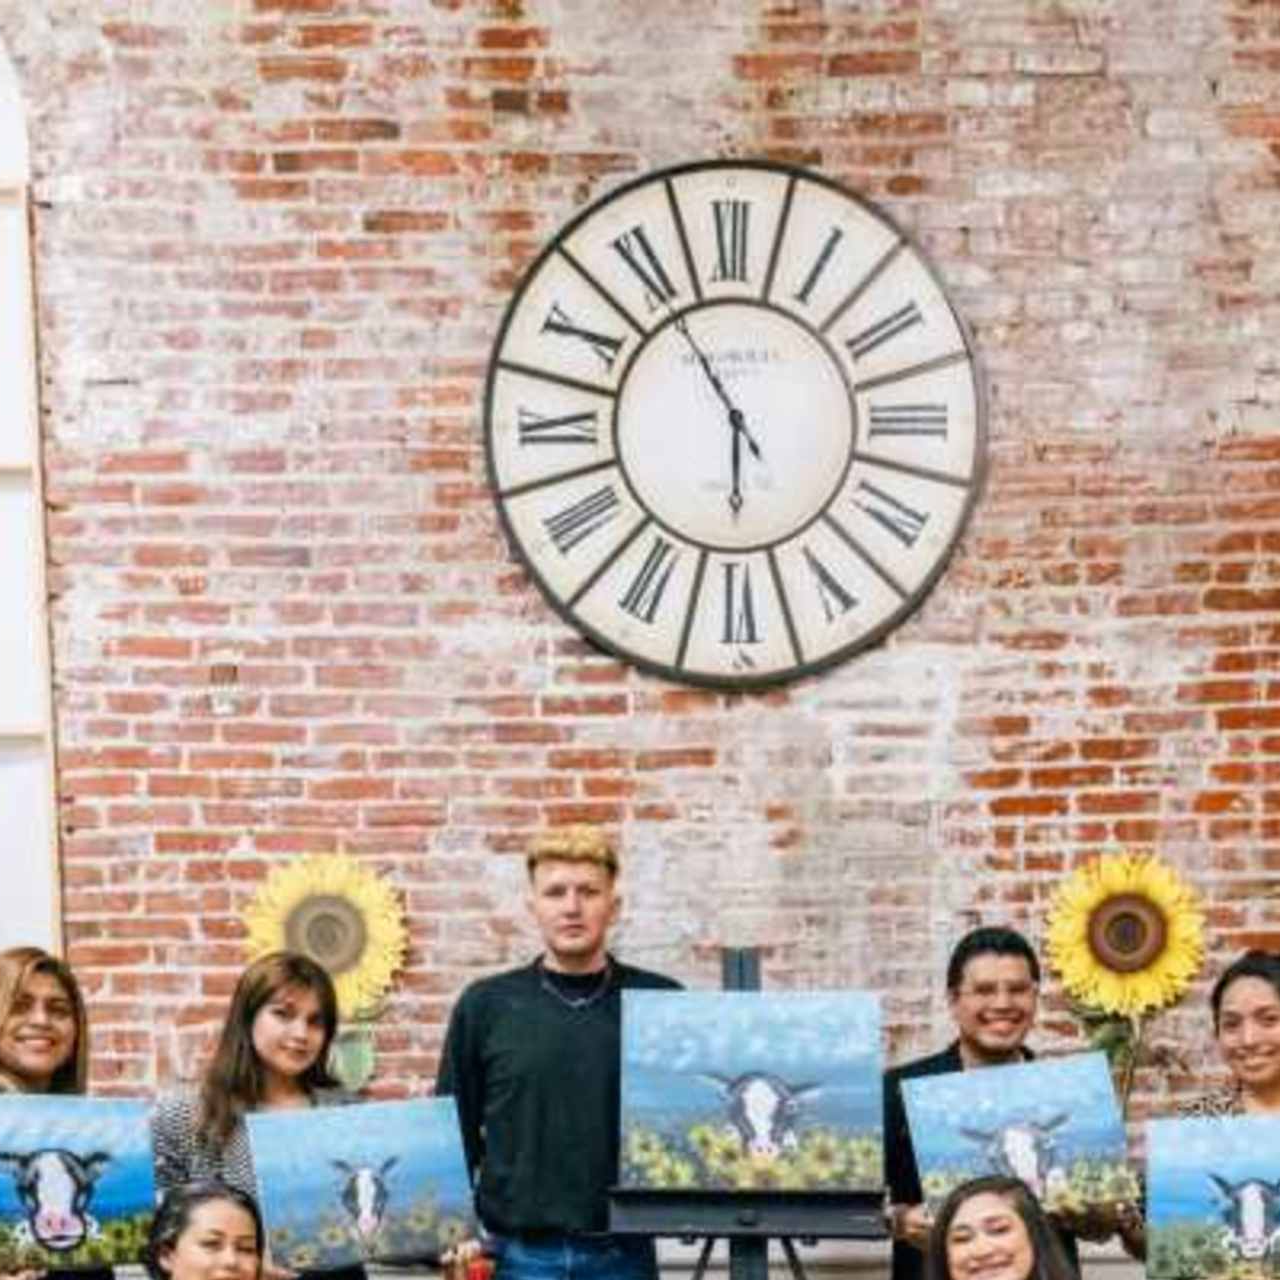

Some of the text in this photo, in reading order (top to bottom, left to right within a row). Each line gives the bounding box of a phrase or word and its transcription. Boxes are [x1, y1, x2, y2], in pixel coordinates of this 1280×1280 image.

[610, 224, 677, 313] XI
[710, 199, 752, 282] XII
[793, 226, 844, 304] I
[541, 302, 626, 373] X
[845, 301, 926, 360] II
[518, 406, 599, 444] IX
[869, 403, 949, 437] III
[543, 484, 622, 556] VIII
[850, 480, 931, 548] IV
[618, 536, 681, 625] VII
[721, 563, 764, 643] VI
[802, 546, 860, 624] V
